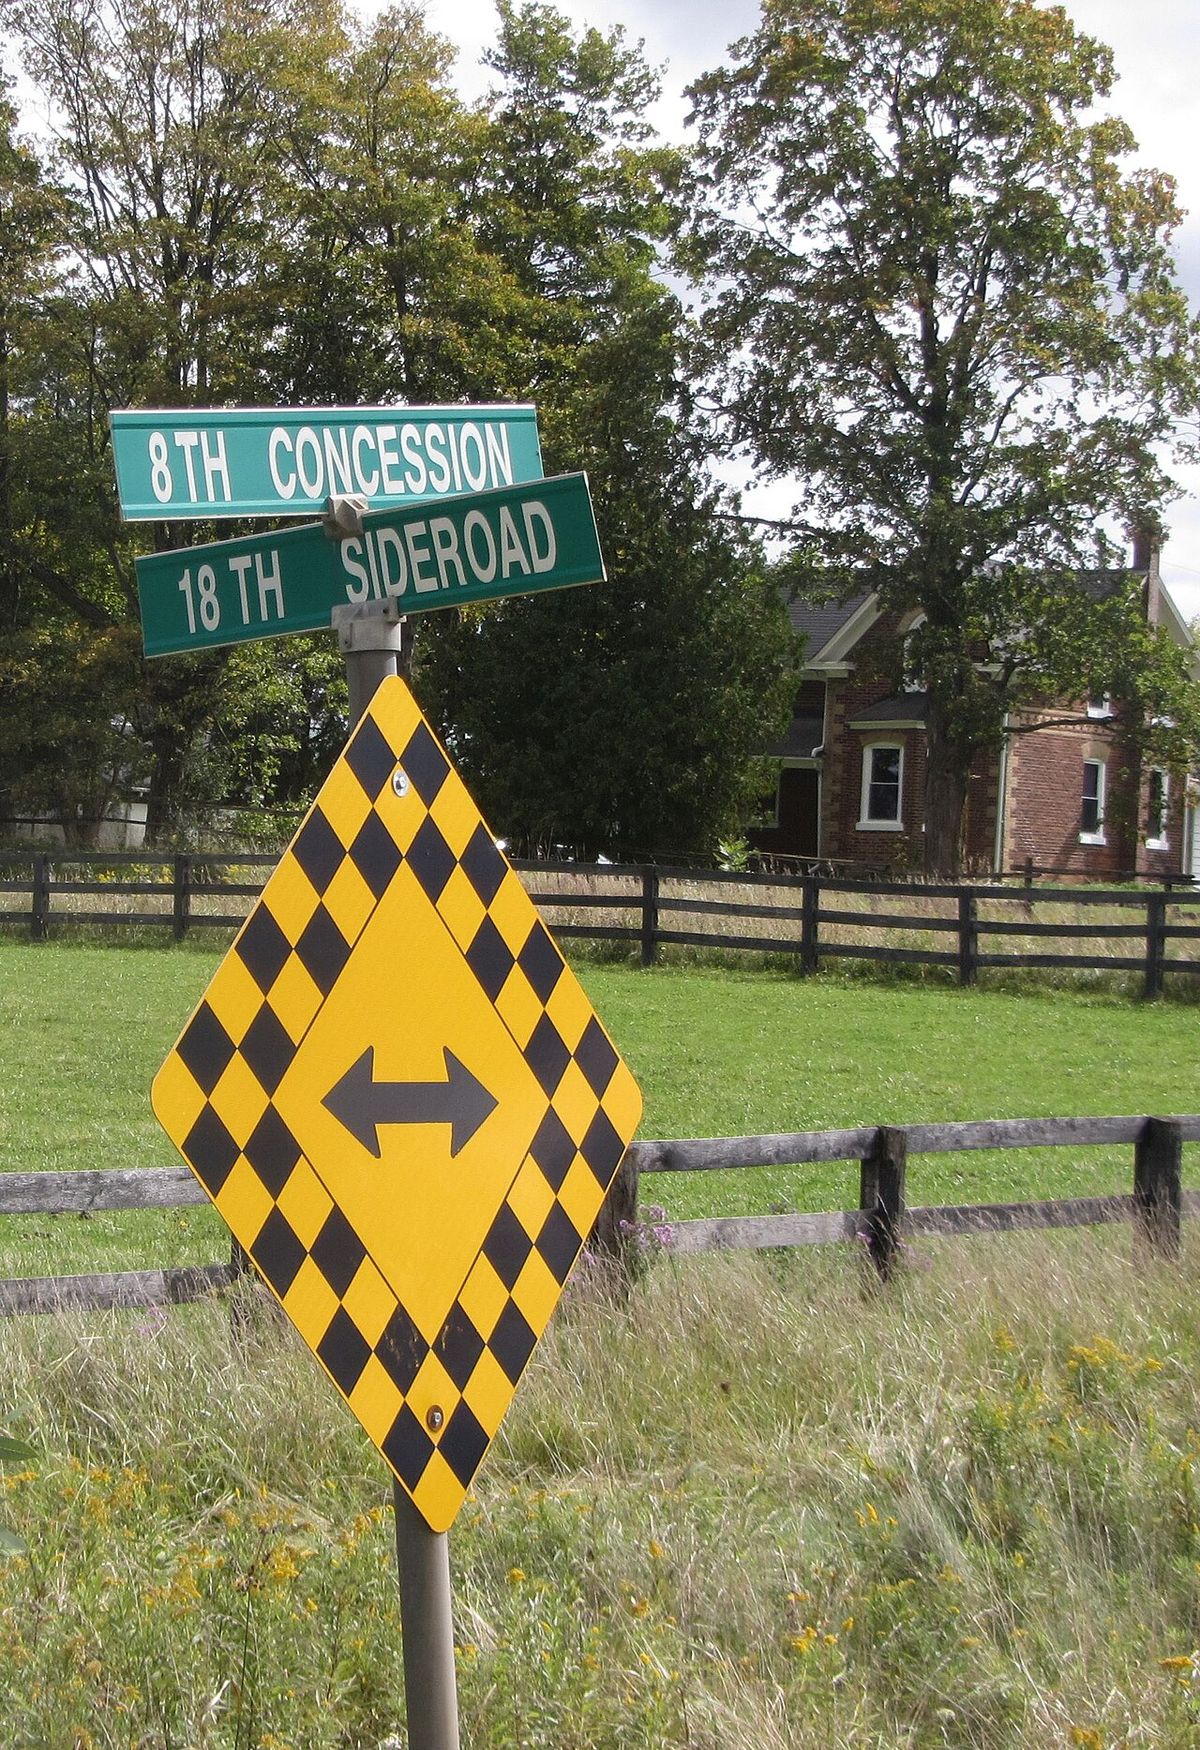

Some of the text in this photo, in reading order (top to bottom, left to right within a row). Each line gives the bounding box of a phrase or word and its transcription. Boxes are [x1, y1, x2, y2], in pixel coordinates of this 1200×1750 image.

[148, 422, 513, 503] 8TH CONCESSION
[340, 501, 558, 603] SIDEROAD
